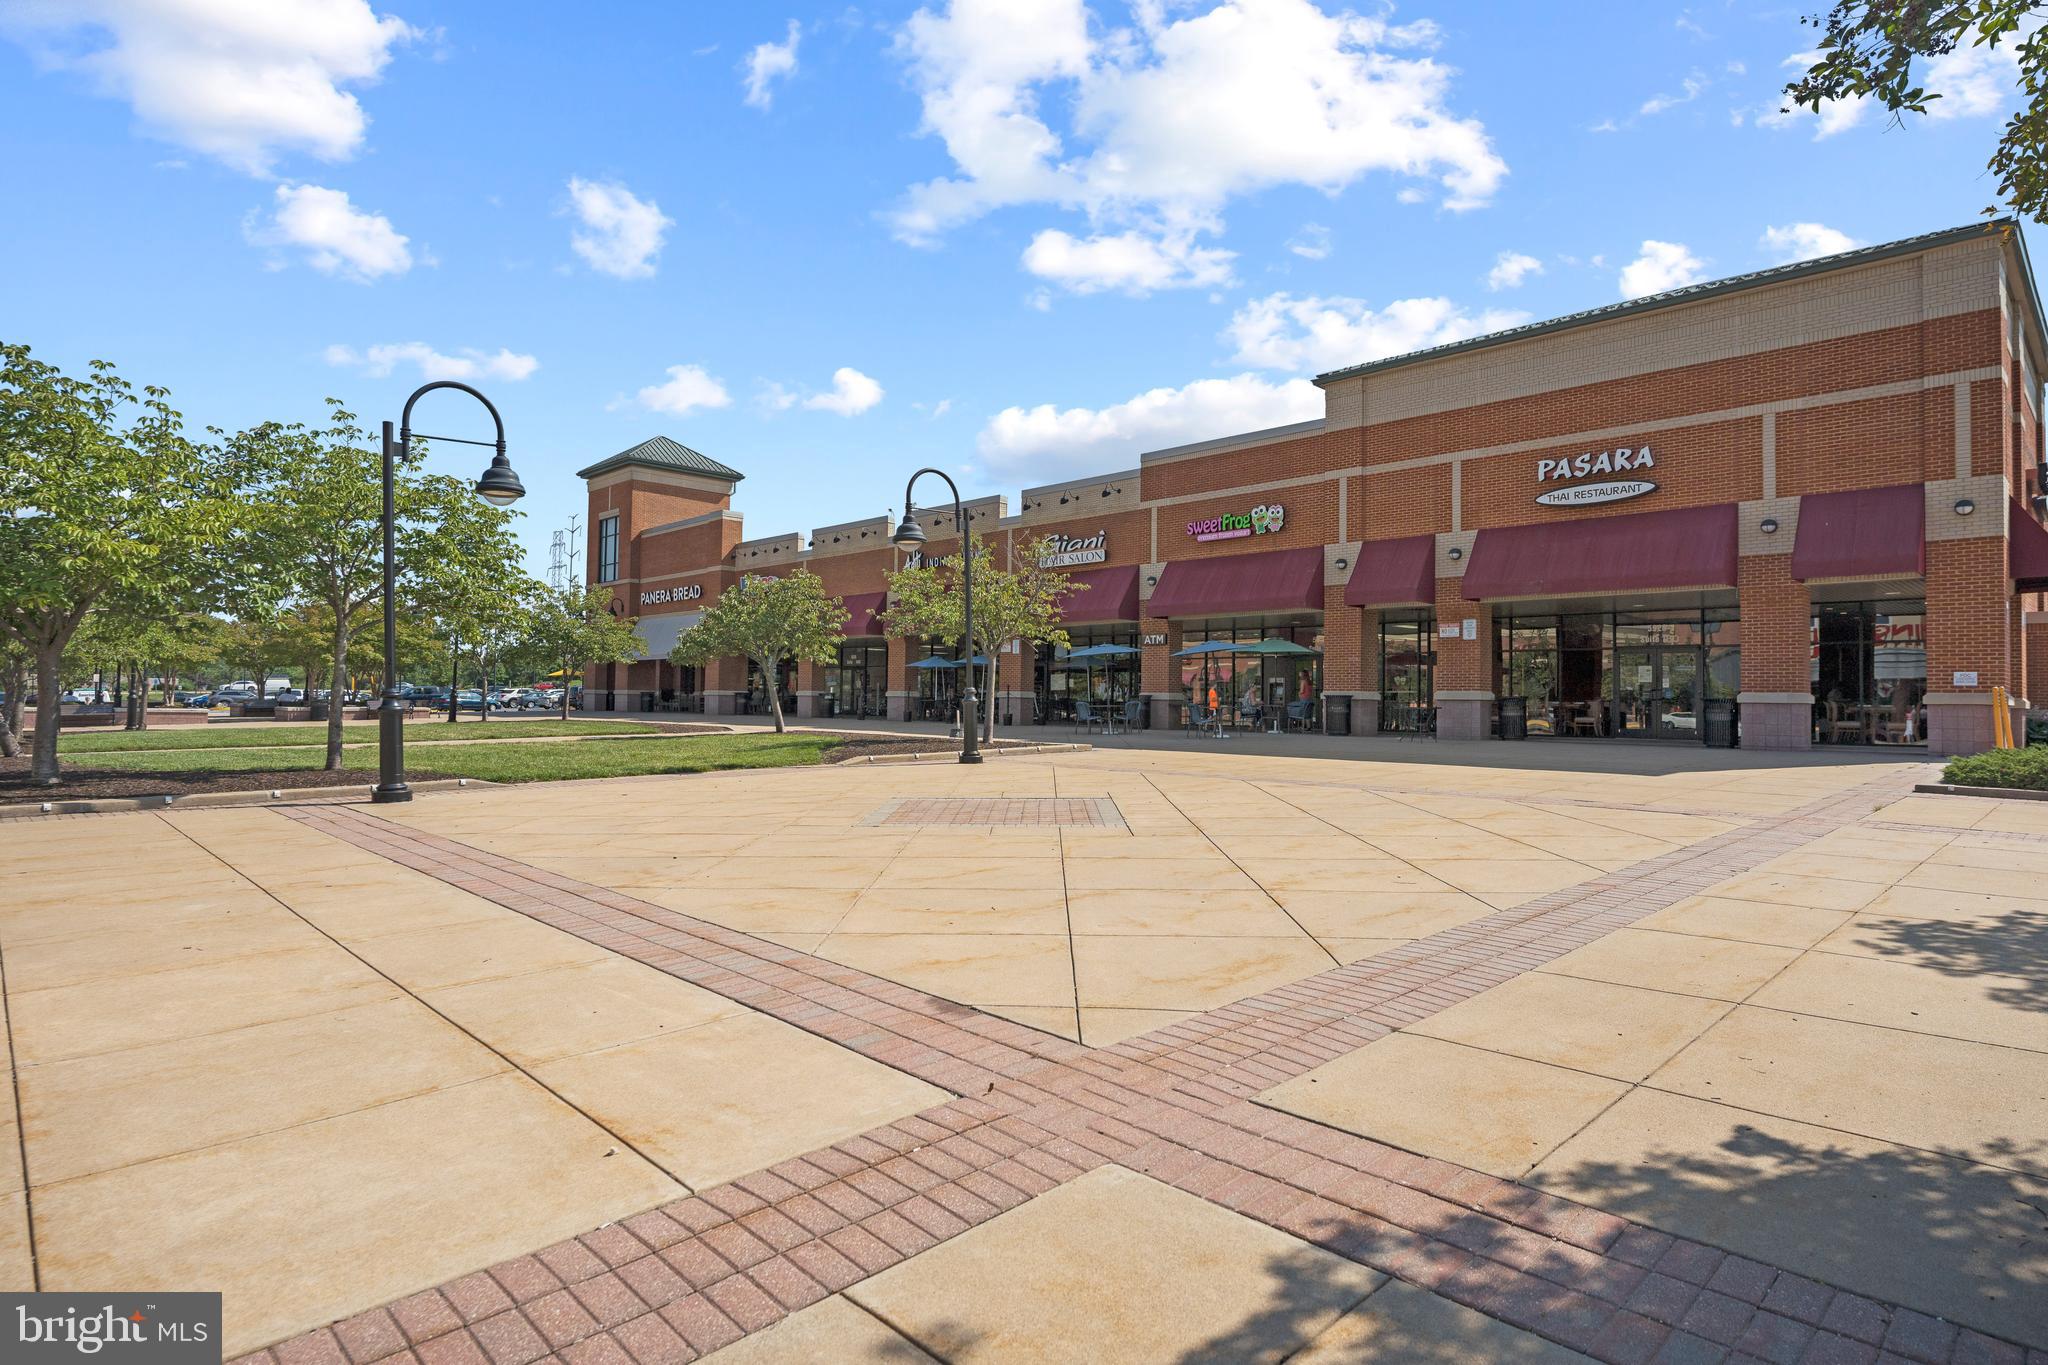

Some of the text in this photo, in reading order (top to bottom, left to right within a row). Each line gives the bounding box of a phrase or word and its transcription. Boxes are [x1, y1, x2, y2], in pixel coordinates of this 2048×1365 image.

[1537, 445, 1655, 482] PASARA
[1547, 483, 1643, 503] THAI RESTAURANT
[1069, 550, 1104, 564] SALON
[640, 584, 701, 606] PANERA BREAD
[1143, 634, 1164, 645] ATM
